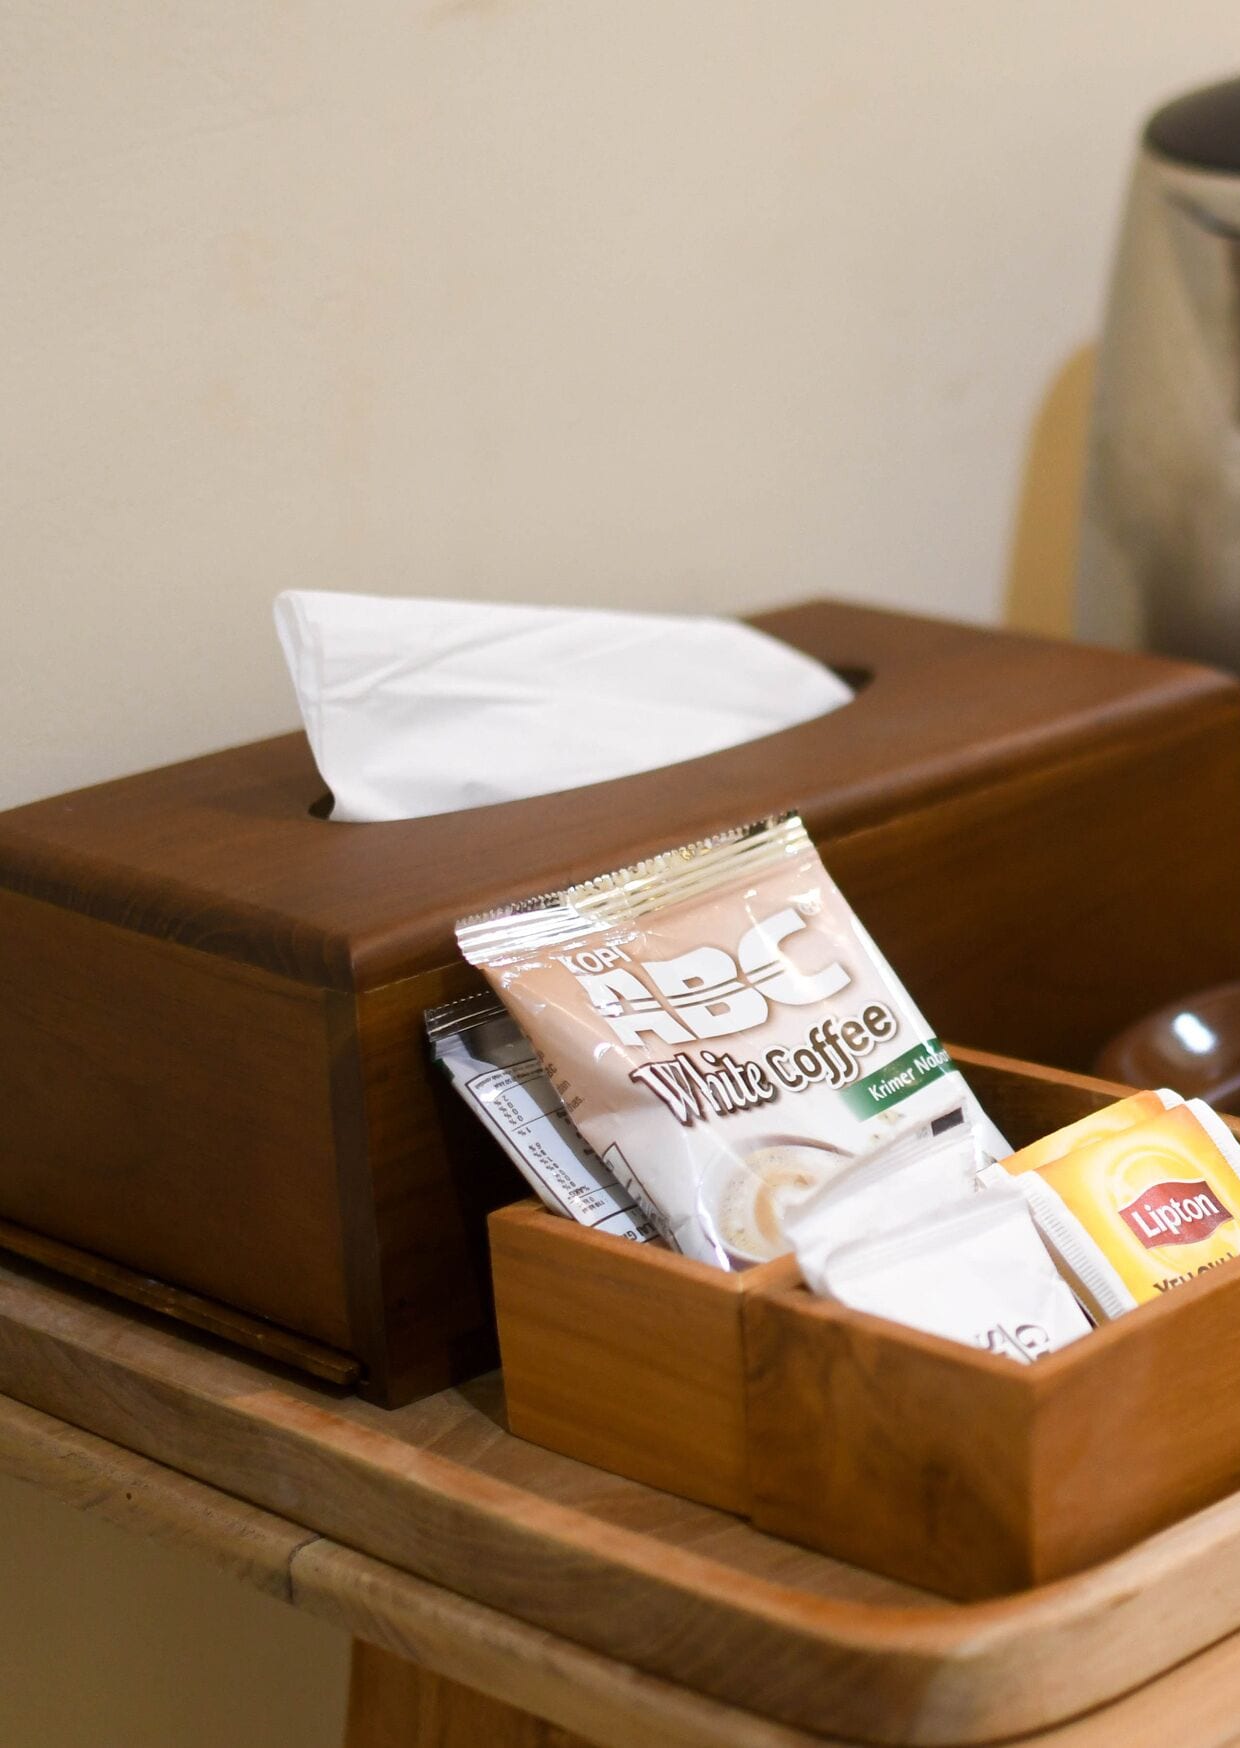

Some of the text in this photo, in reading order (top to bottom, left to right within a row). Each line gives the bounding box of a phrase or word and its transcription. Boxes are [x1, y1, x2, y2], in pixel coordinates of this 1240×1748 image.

[556, 945, 632, 974] KOPI
[567, 907, 851, 1046] ABC
[628, 1003, 894, 1127] White Coffee
[868, 1068, 915, 1101] Krimer
[1131, 1193, 1219, 1238] Lipton
